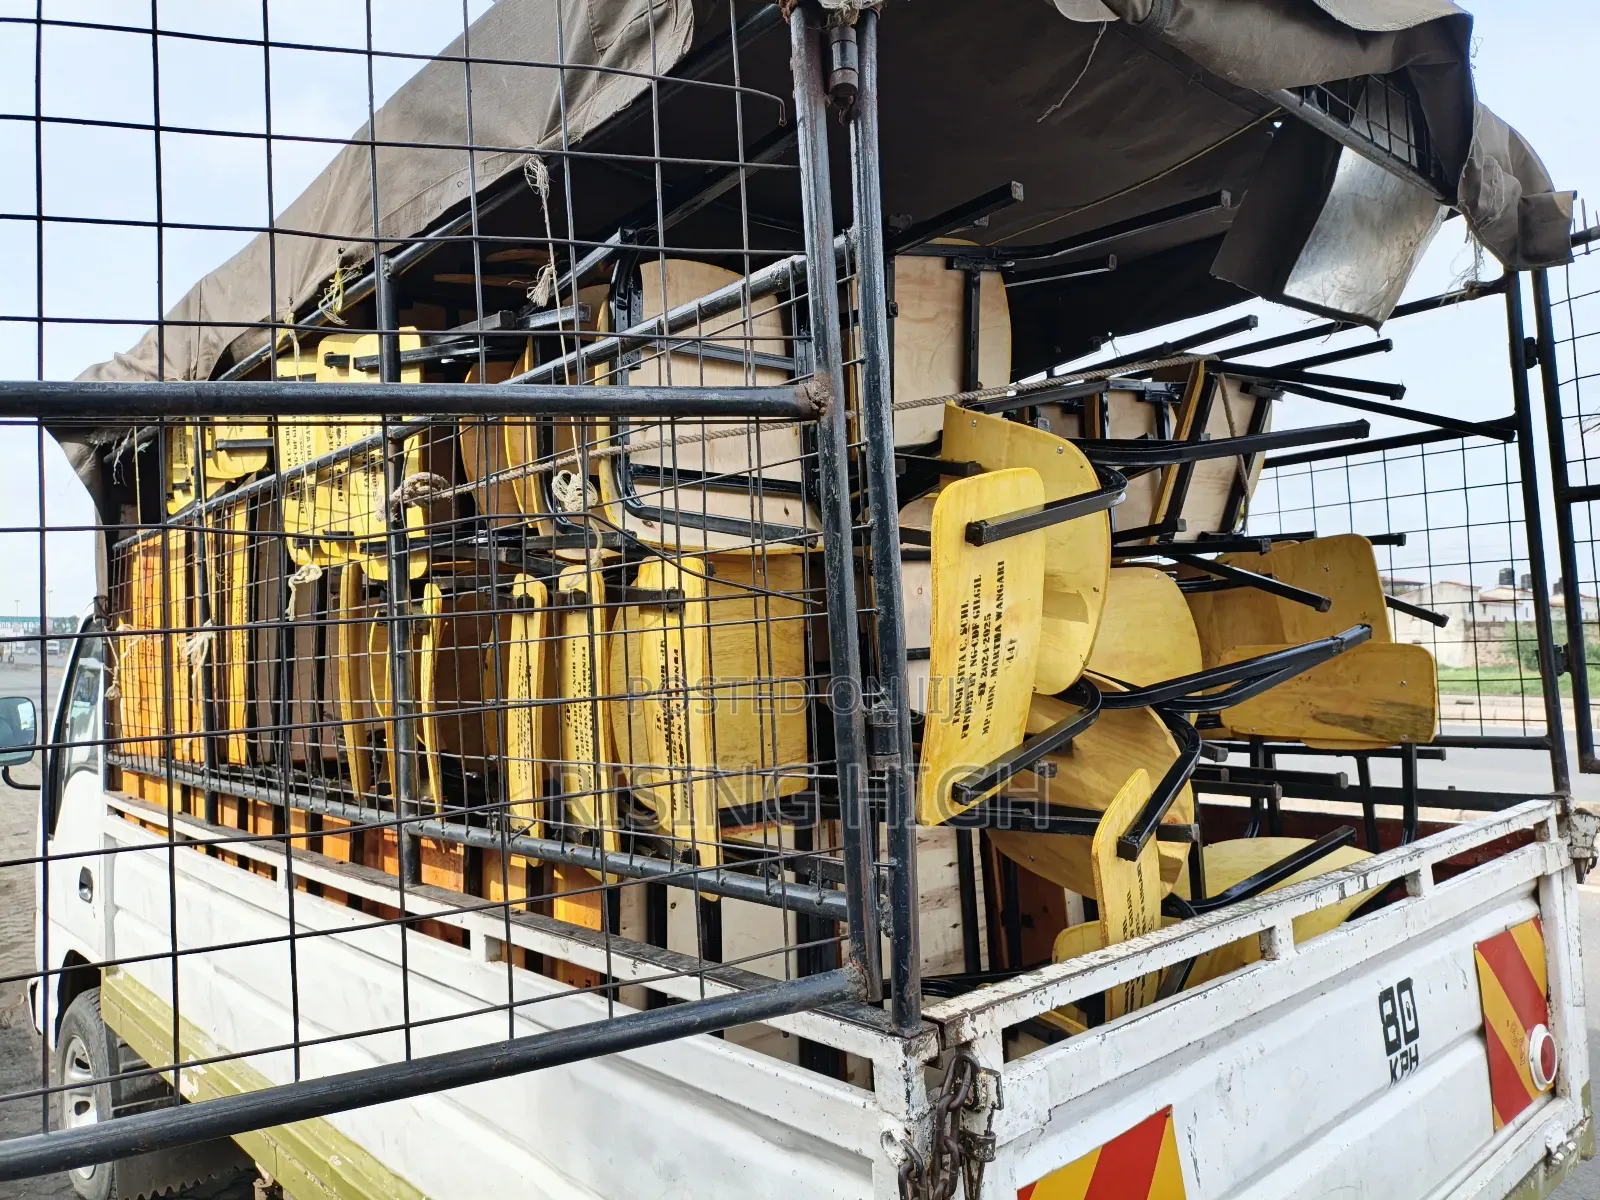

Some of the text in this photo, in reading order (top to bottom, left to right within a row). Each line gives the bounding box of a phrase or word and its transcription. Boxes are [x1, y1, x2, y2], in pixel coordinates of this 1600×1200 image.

[995, 560, 1005, 622] WANGARI
[990, 623, 1003, 678] MARTHA
[952, 687, 964, 726] TANGI
[960, 690, 974, 740] FUNDED
[1378, 977, 1419, 1057] 80
[1388, 1044, 1419, 1088] KPH
